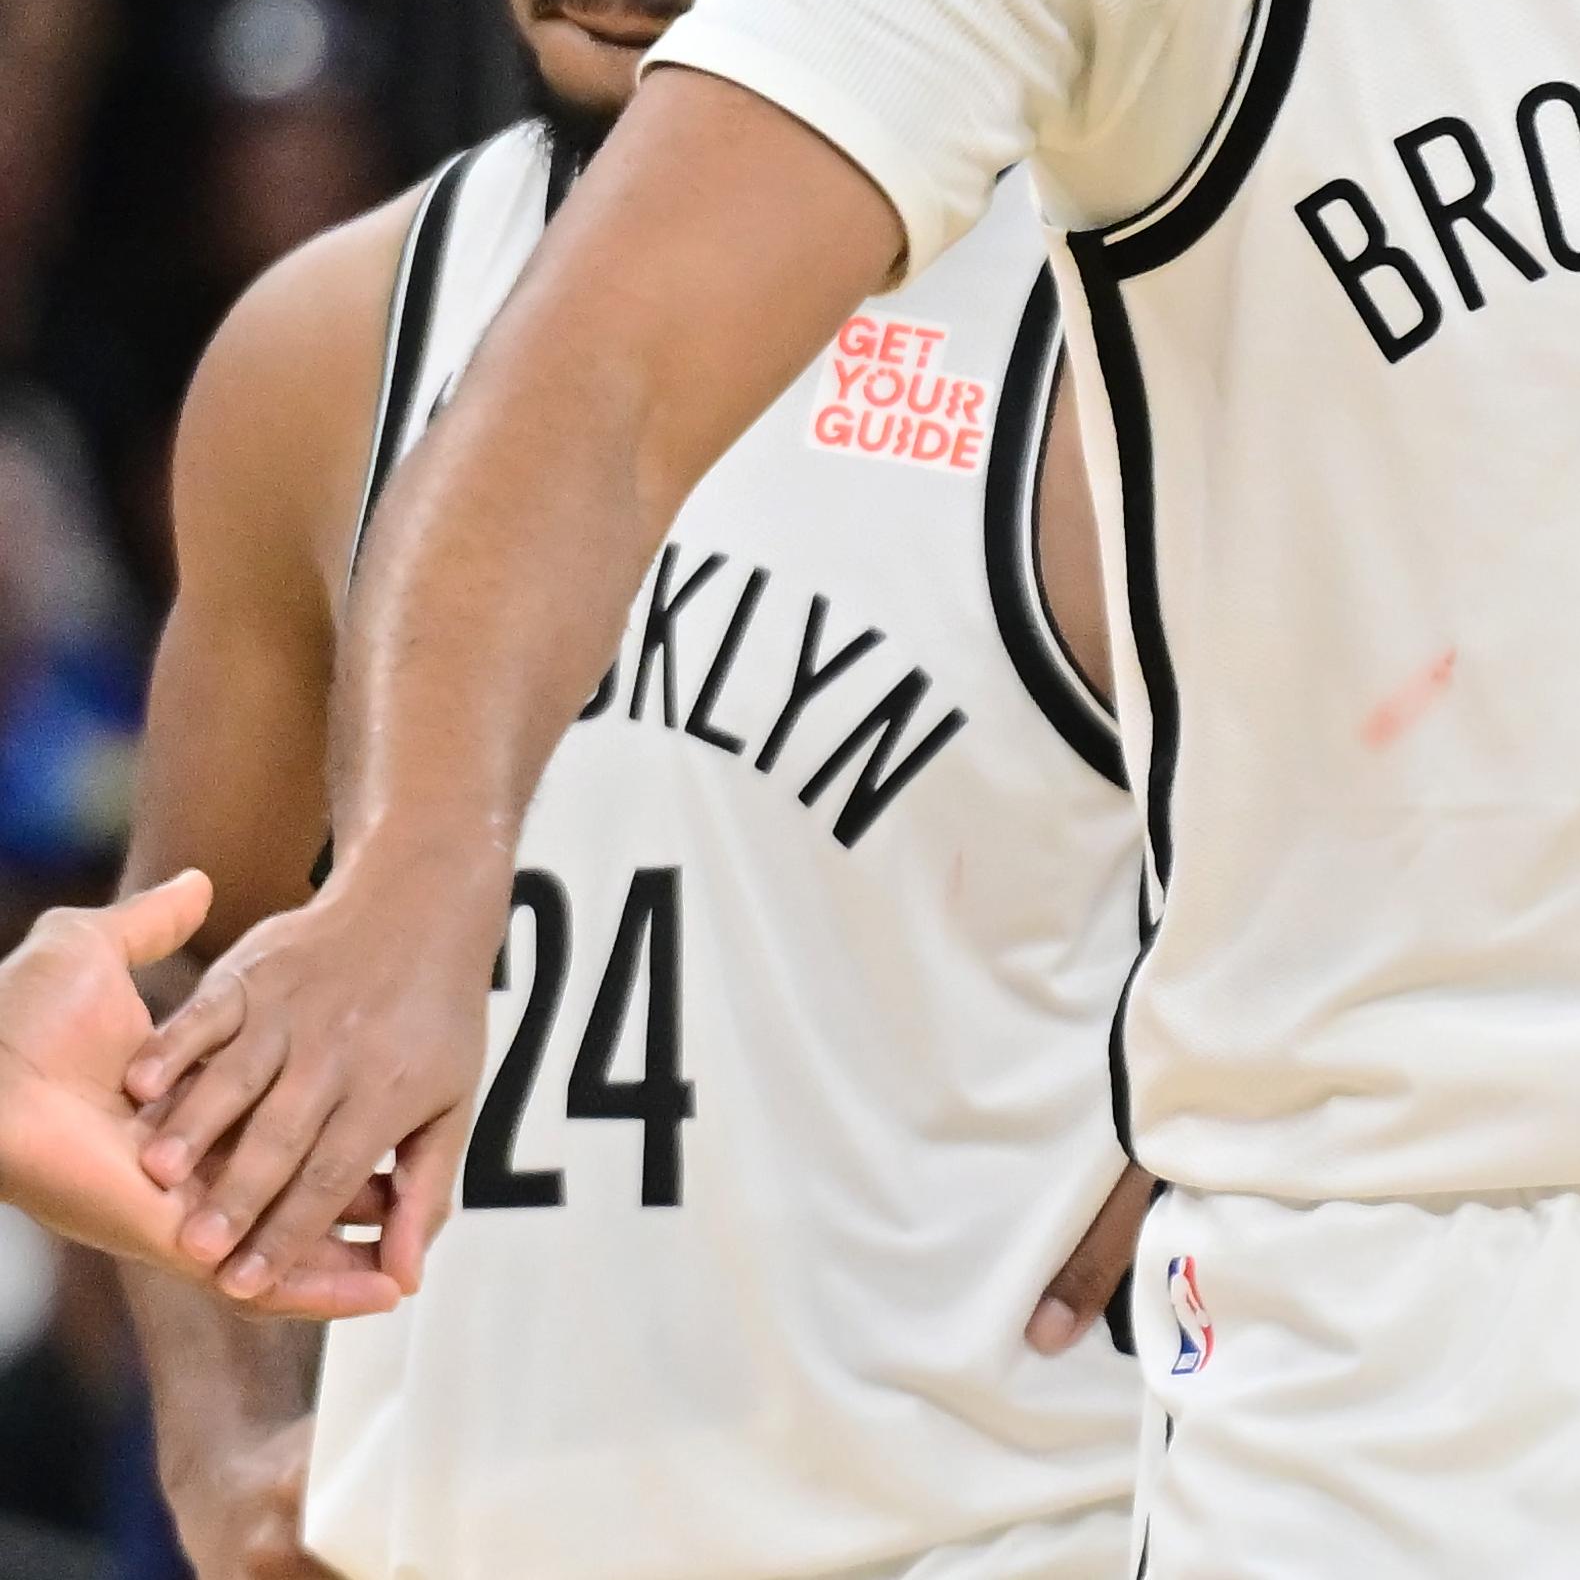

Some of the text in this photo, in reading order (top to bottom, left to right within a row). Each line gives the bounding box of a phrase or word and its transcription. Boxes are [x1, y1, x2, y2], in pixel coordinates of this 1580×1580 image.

[838, 315, 946, 368] GET
[833, 359, 987, 424] YOUR
[814, 404, 985, 469] GUIDE
[577, 543, 968, 850] KLYN
[462, 867, 697, 1209] 24
